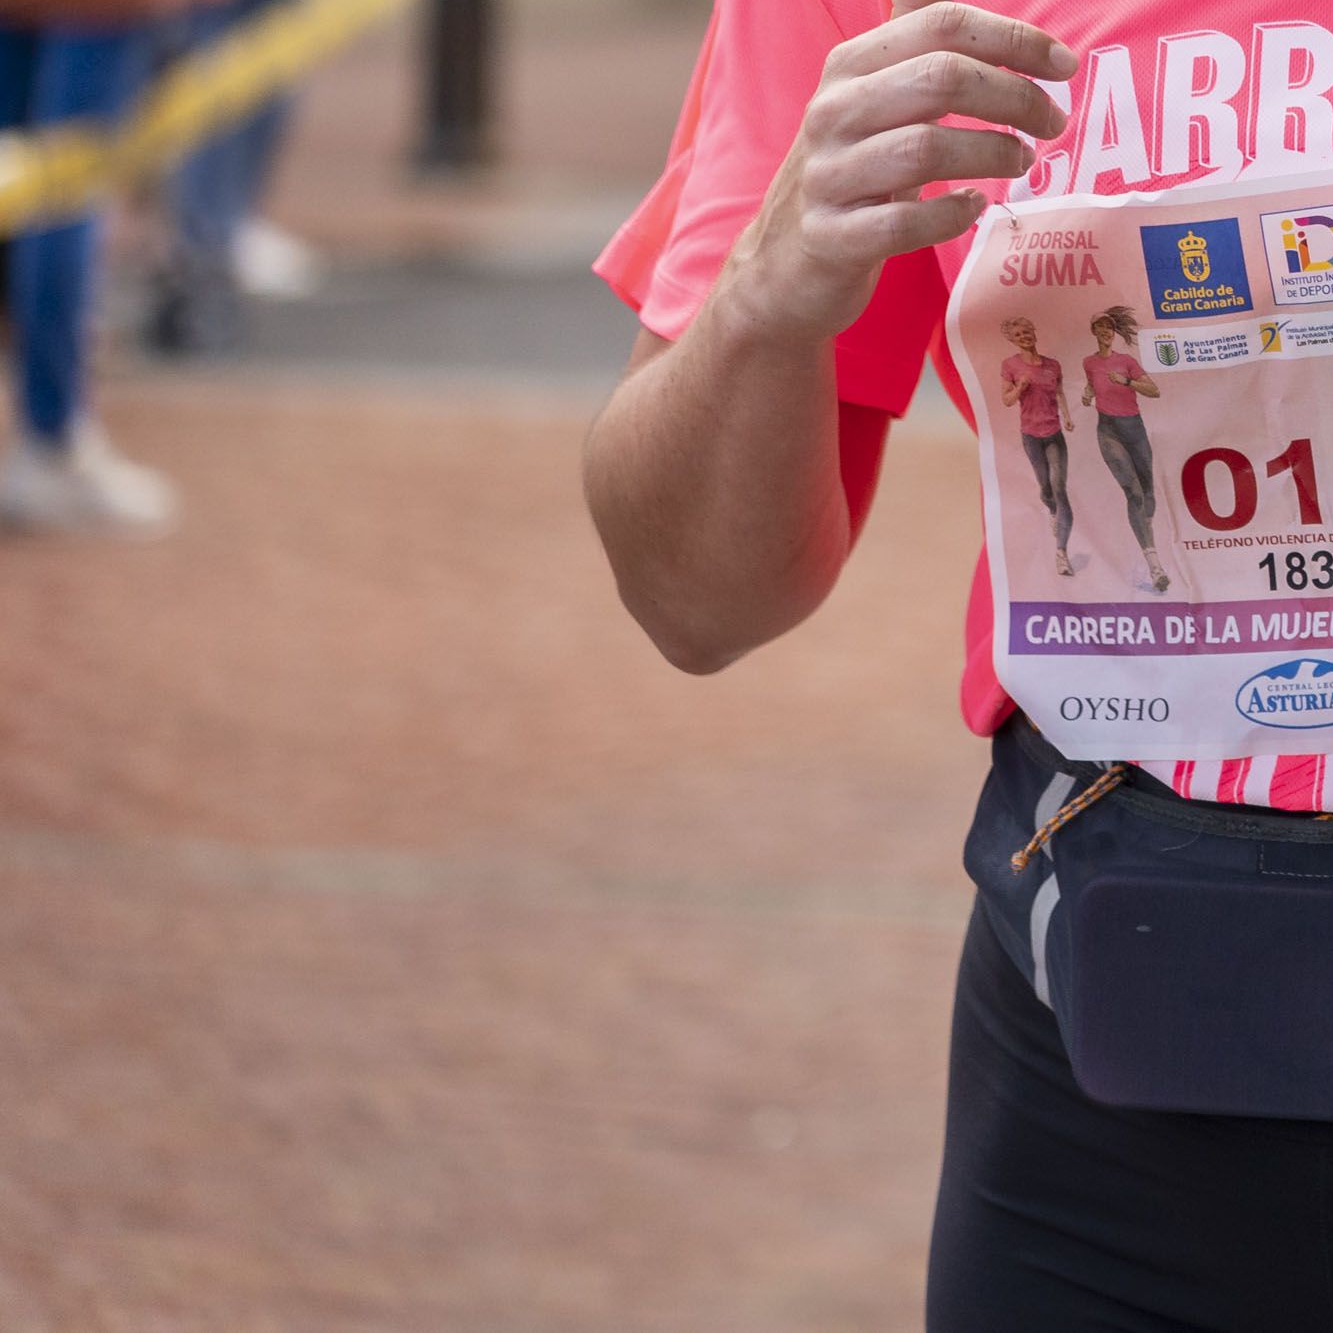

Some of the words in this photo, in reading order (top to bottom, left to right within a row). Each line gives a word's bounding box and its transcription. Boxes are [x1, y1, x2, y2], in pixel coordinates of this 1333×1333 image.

[1009, 233, 1028, 251] TU
[1028, 230, 1099, 250] DORSAL
[999, 253, 1105, 287] SUMA
[1281, 274, 1324, 286] INSTITUTO
[1164, 286, 1215, 301] Cabildo
[1217, 284, 1234, 296] de
[1287, 289, 1298, 298] DE
[1160, 301, 1195, 313] Gran
[1196, 296, 1245, 311] Canaria
[1184, 334, 1247, 348] Ayuntamiento
[1217, 342, 1248, 352] Palmas
[1186, 355, 1197, 363] de
[1197, 355, 1217, 363] Gran
[1218, 349, 1249, 361] Canaria
[1183, 536, 1254, 551] TELÉFONO
[1256, 533, 1327, 546] VIOLENCIA
[1025, 615, 1156, 645] CARRERA
[1165, 614, 1196, 645] DE
[1205, 615, 1241, 643] LA
[1267, 682, 1313, 692] CENTRAL
[1060, 696, 1170, 723] OYSHO
